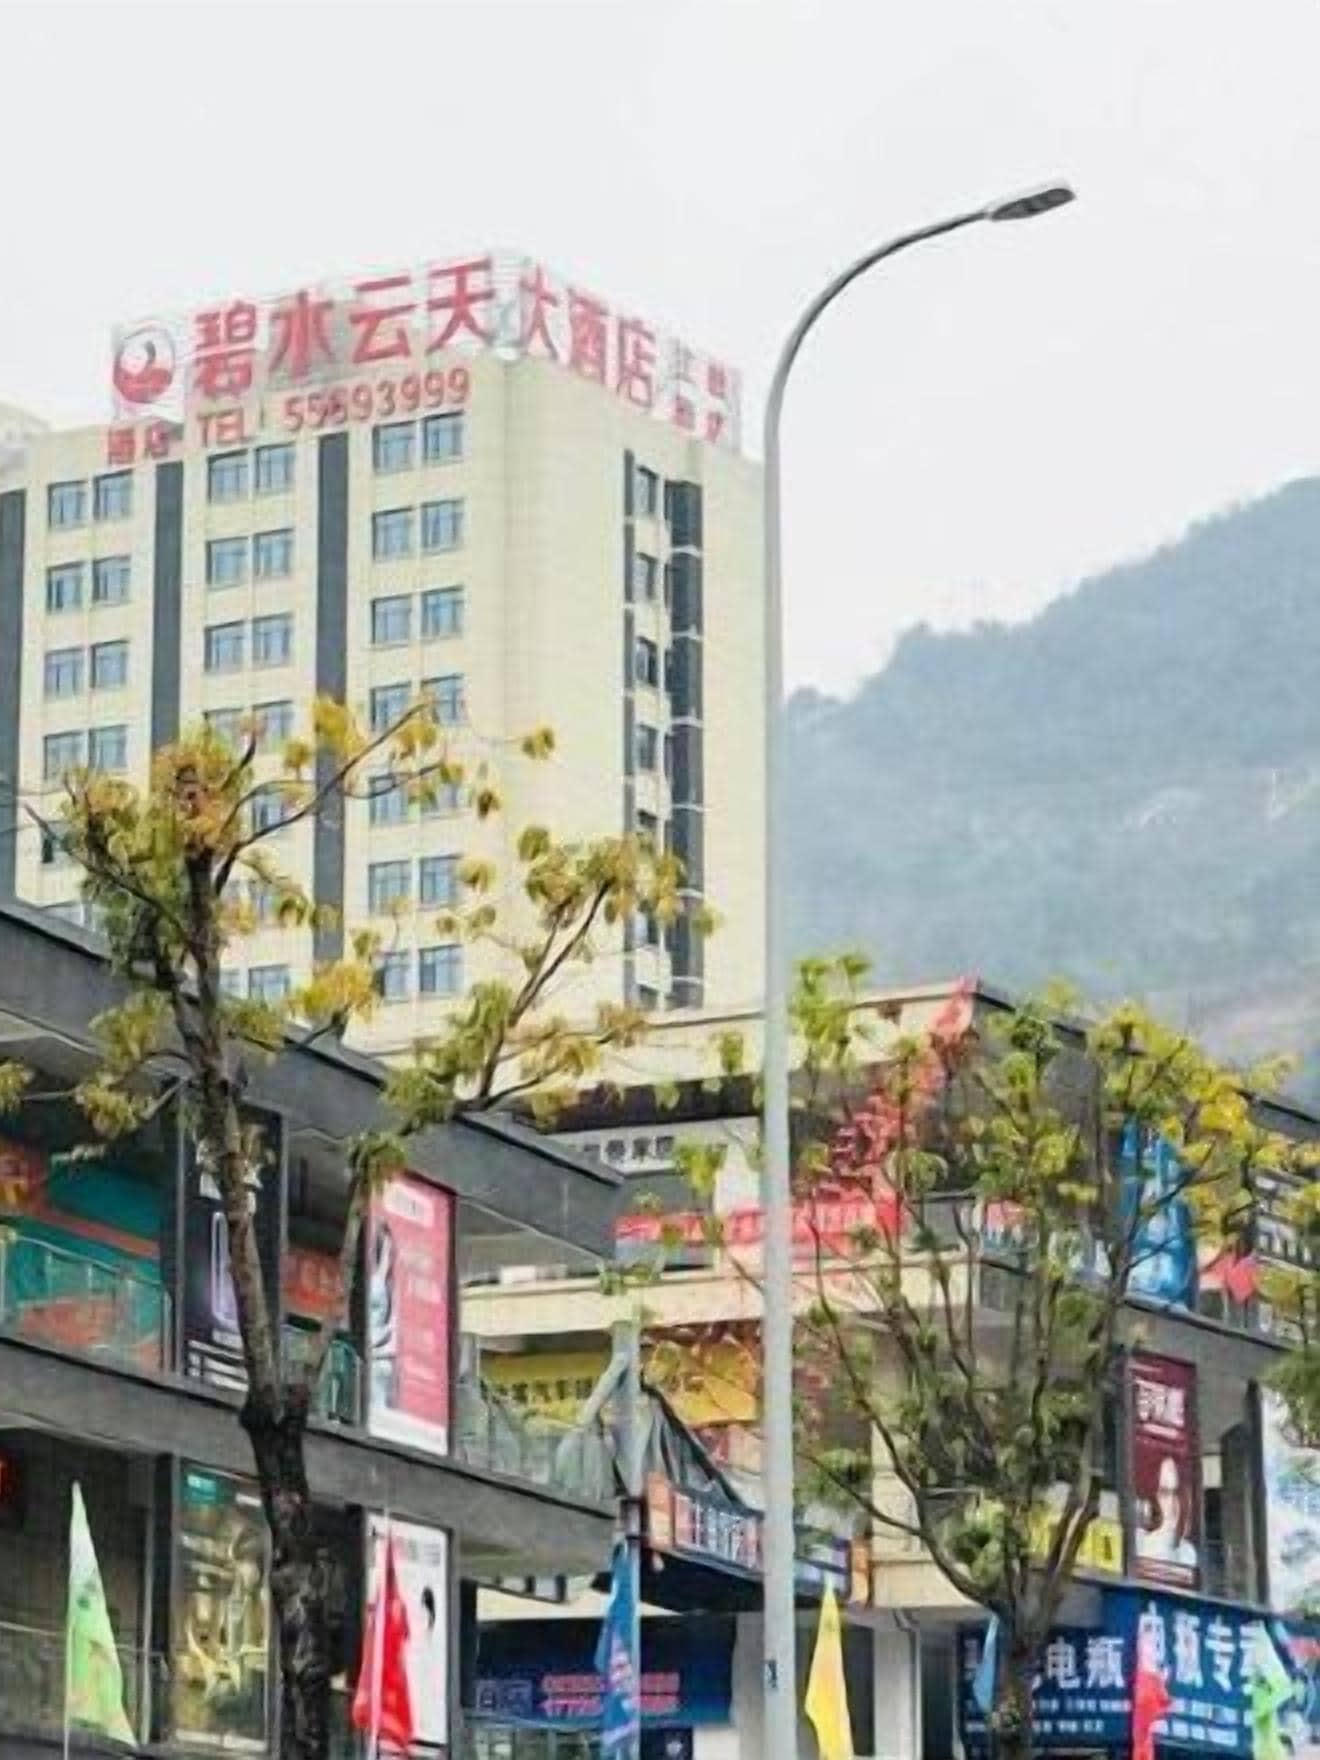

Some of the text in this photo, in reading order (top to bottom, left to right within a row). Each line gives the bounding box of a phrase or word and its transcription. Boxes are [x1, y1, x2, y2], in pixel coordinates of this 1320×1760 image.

[194, 257, 496, 400] 碧水云天
[519, 265, 656, 408] 大酒店
